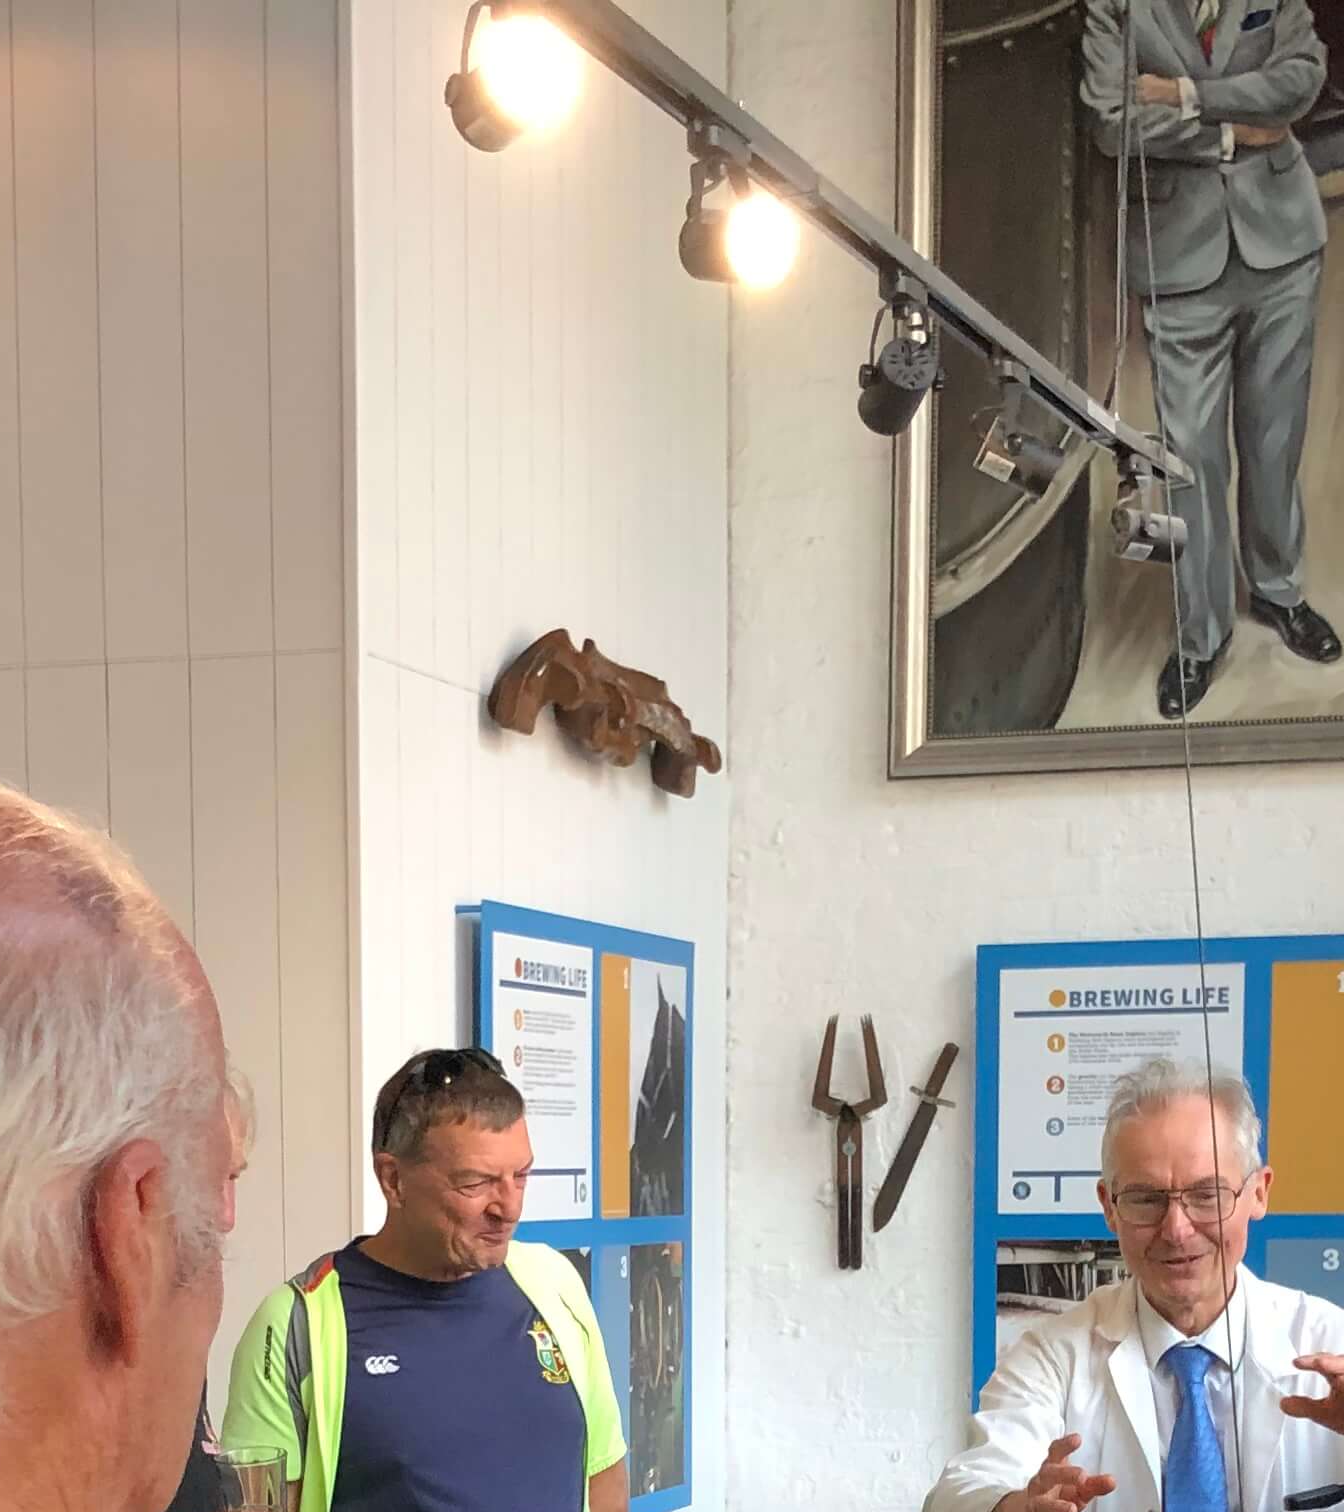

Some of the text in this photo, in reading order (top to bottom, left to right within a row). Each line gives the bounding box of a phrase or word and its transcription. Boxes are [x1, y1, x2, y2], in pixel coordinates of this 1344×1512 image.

[523, 960, 587, 988] BREWING LIFE
[623, 967, 629, 989] 1
[1069, 987, 1230, 1008] BREWING LIFE
[620, 1255, 627, 1278] 3
[1322, 1249, 1340, 1271] 3
